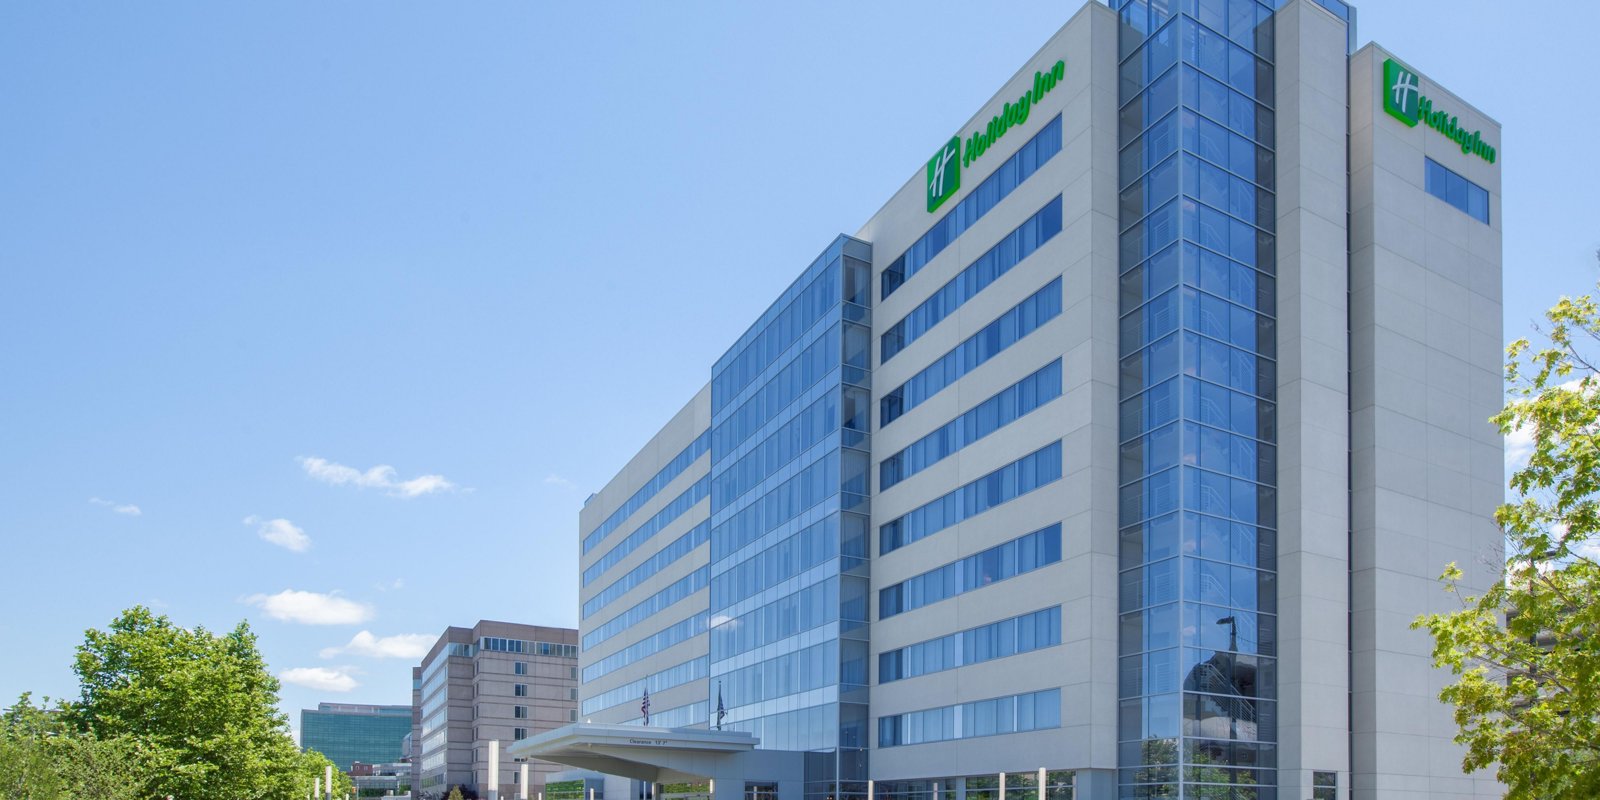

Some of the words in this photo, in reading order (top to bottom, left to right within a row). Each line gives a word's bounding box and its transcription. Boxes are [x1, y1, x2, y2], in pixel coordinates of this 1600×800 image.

[963, 90, 1031, 168] Holiday
[1032, 60, 1065, 104] Inn
[1392, 71, 1418, 113] H
[1417, 96, 1473, 154] Holiday
[1472, 131, 1496, 164] Inn
[930, 146, 955, 197] H
